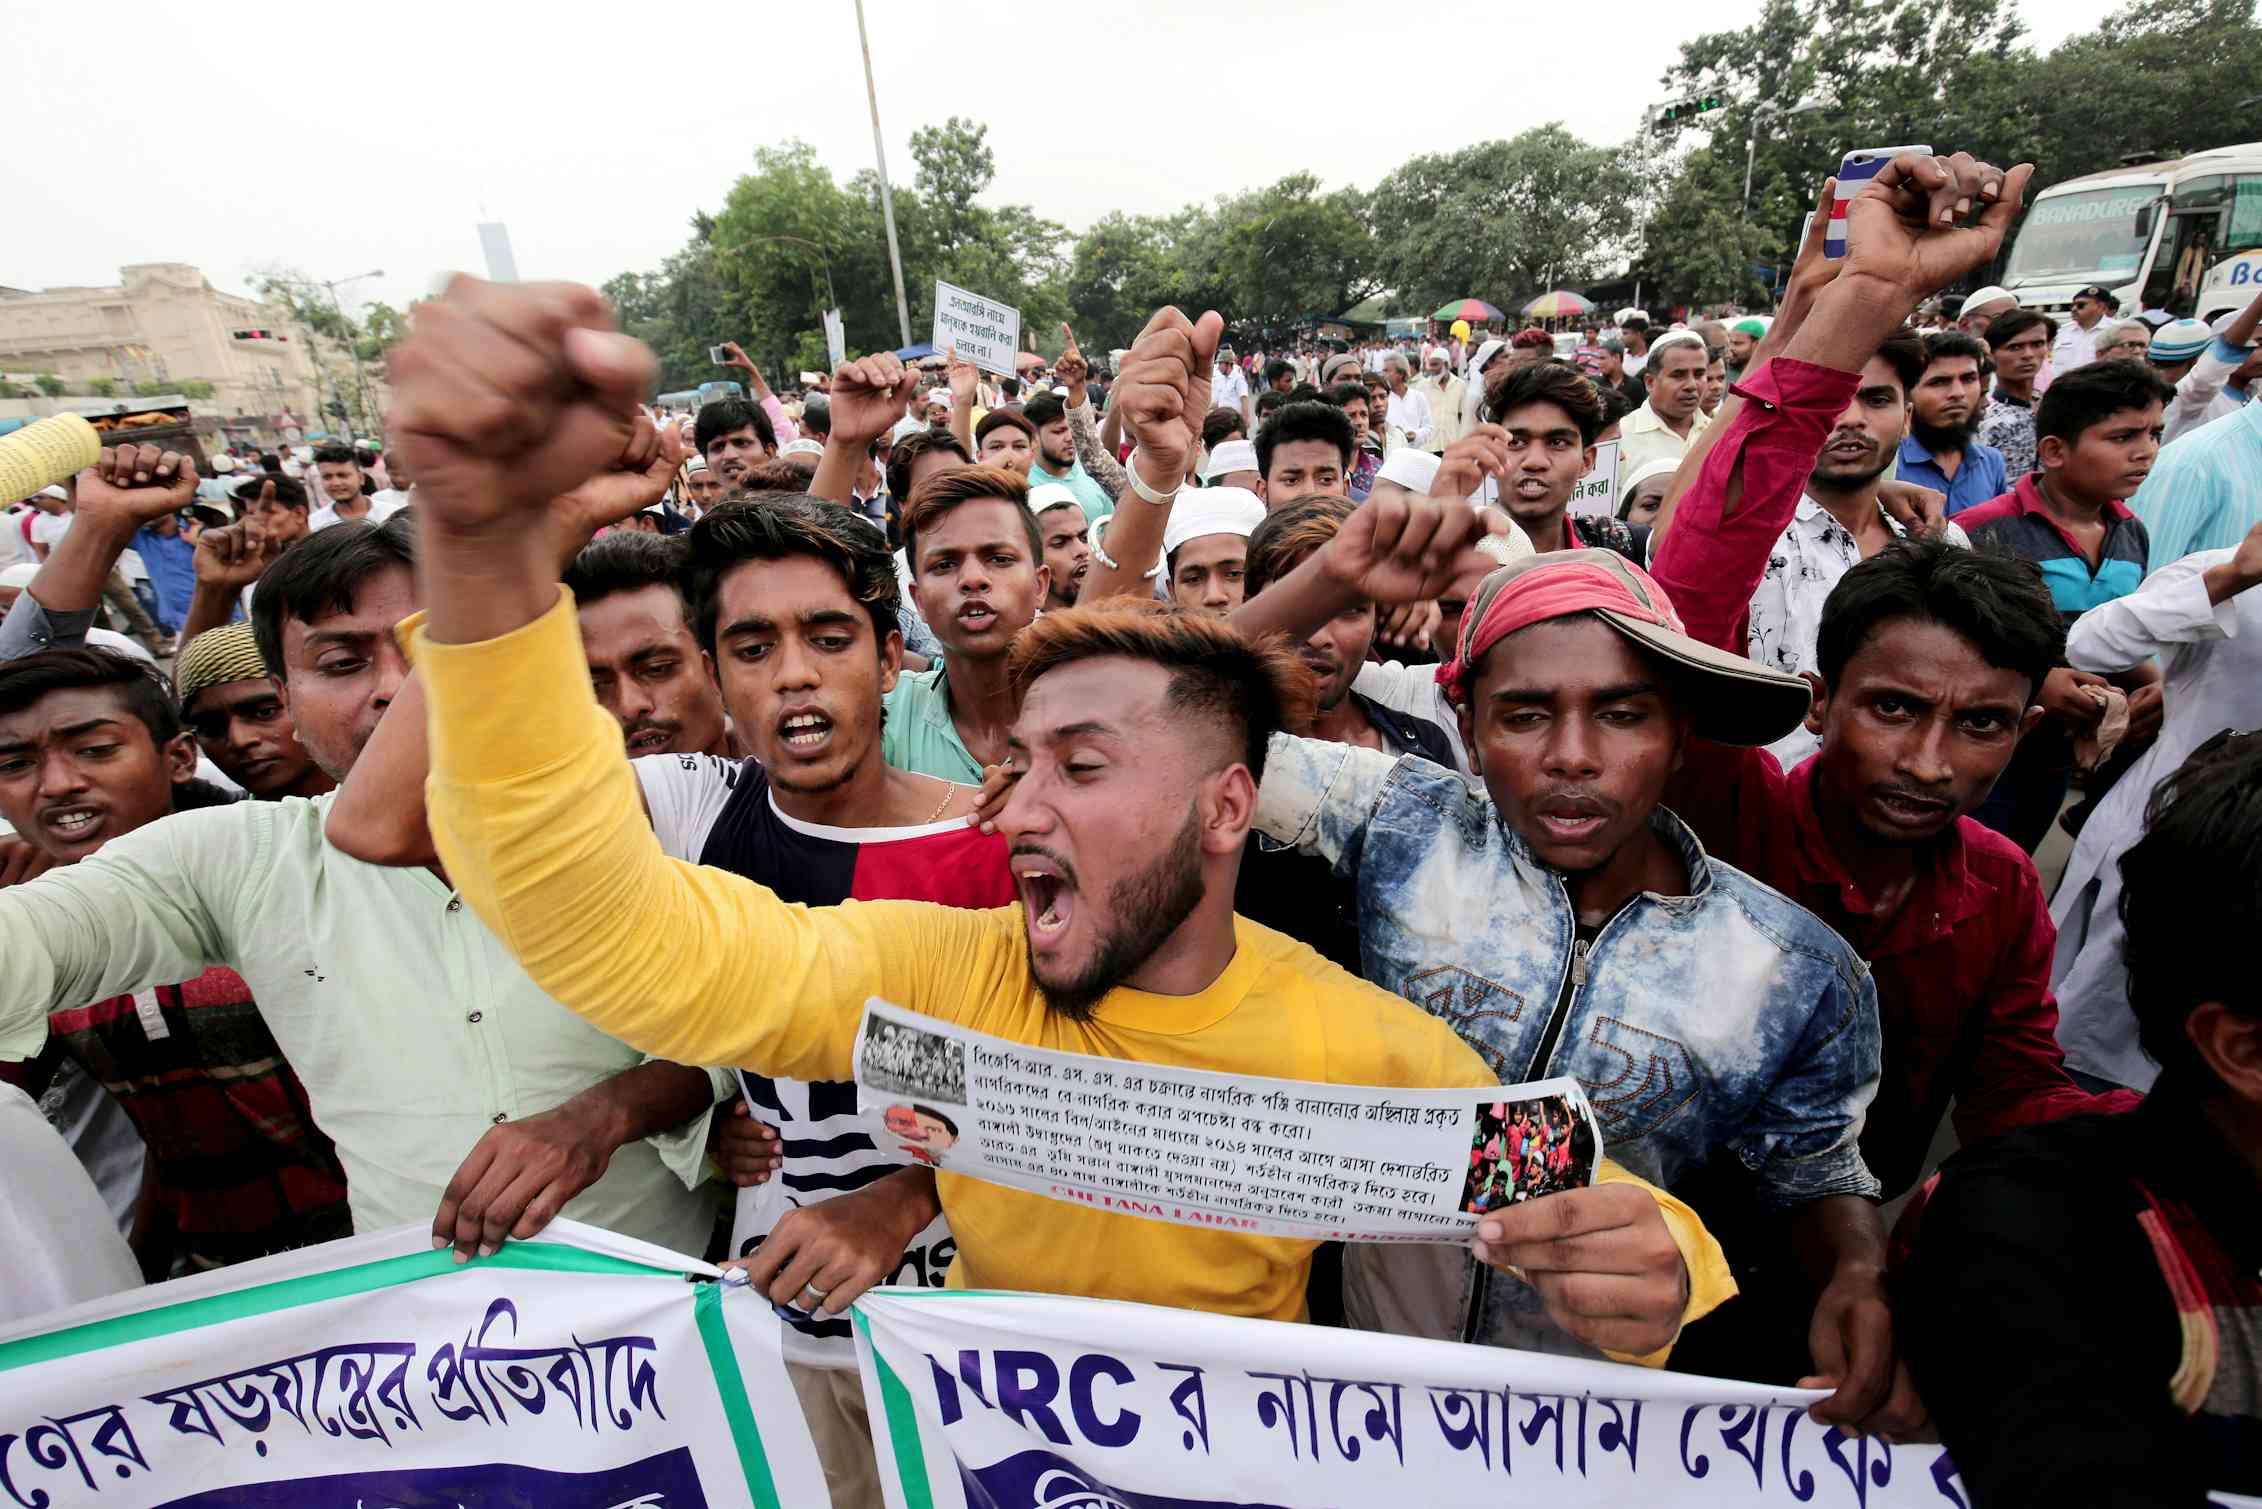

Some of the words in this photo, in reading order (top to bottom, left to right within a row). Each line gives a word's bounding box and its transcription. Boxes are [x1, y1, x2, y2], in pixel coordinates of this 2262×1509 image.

[2033, 197, 2144, 225] BANADURG
[973, 1074, 1049, 1101] নাগরিকদের
[1134, 1102, 1174, 1121] করার
[1177, 1108, 1237, 1129] অপচেষ্টা
[1241, 1117, 1266, 1134] বন্ধ
[1199, 1085, 1258, 1108] নাগরিক
[1295, 1098, 1361, 1121] বানানোর
[1423, 1107, 1462, 1129] প্রকৃত
[1019, 1104, 1061, 1124] সালের
[1151, 1127, 1200, 1147] মাধ্যমে
[1205, 1135, 1247, 1154] ২০১৪
[1251, 1143, 1294, 1162] সালের
[1298, 1150, 1336, 1168] আগে
[1338, 1155, 1377, 1174] আসা
[1117, 1142, 1162, 1161] থাকতে
[1165, 1150, 1206, 1169] দেওয়া
[1245, 1161, 1293, 1183] শর্তহীন
[1296, 1173, 1361, 1195] নাগরিকত্ব
[1363, 1179, 1399, 1200] দিতে
[1163, 1169, 1243, 1194] মুসলমানদের
[0, 1405, 152, 1509] ণের
[139, 1342, 423, 1458] ষড়যন্ত্রের
[427, 1297, 666, 1433] প্রতিবাদে
[922, 1350, 1141, 1447] NRC
[1244, 1368, 1406, 1467] নামে
[1424, 1384, 1650, 1478] আসাম
